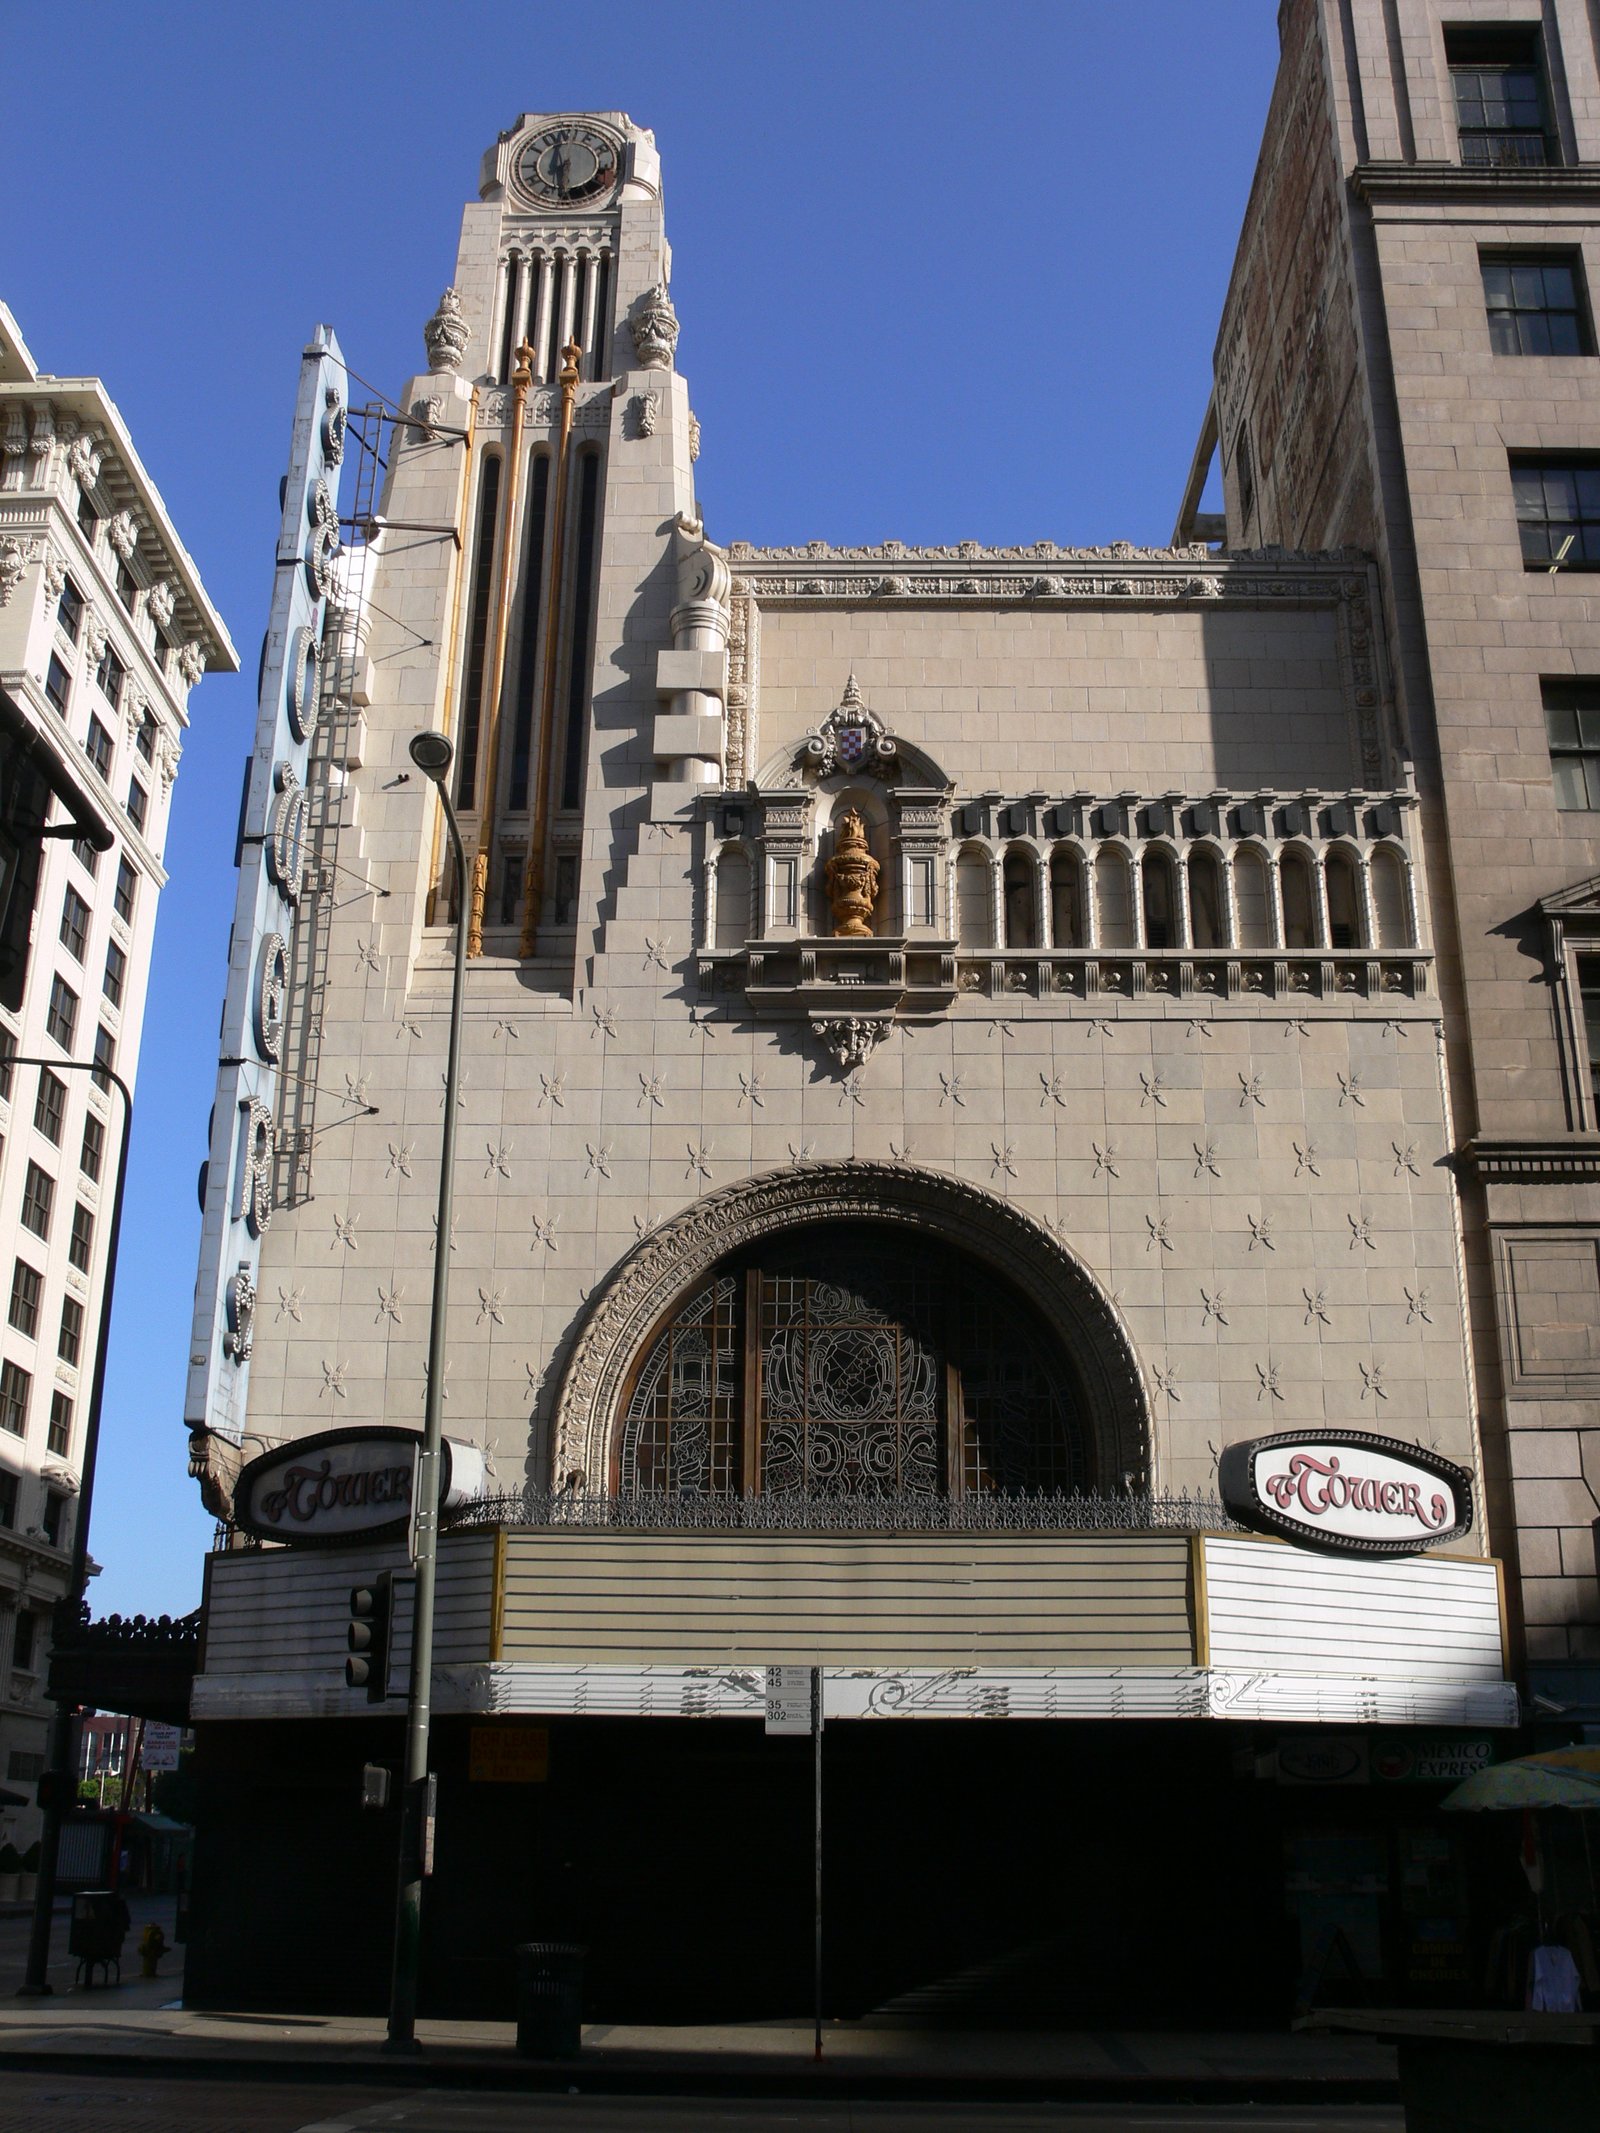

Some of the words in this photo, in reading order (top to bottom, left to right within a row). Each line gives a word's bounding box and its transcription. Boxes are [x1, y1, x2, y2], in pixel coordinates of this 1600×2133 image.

[284, 1459, 412, 1520] TOWER
[1288, 1453, 1448, 1530] TOWER
[768, 1667, 782, 1677] 42
[767, 1678, 782, 1688] 45
[767, 1700, 782, 1710] 35
[767, 1711, 787, 1721] 302
[473, 1730, 501, 1746] FOR
[504, 1730, 546, 1748] LEASE
[1417, 1743, 1490, 1759] MEXICO
[1430, 1956, 1448, 1968] DE
